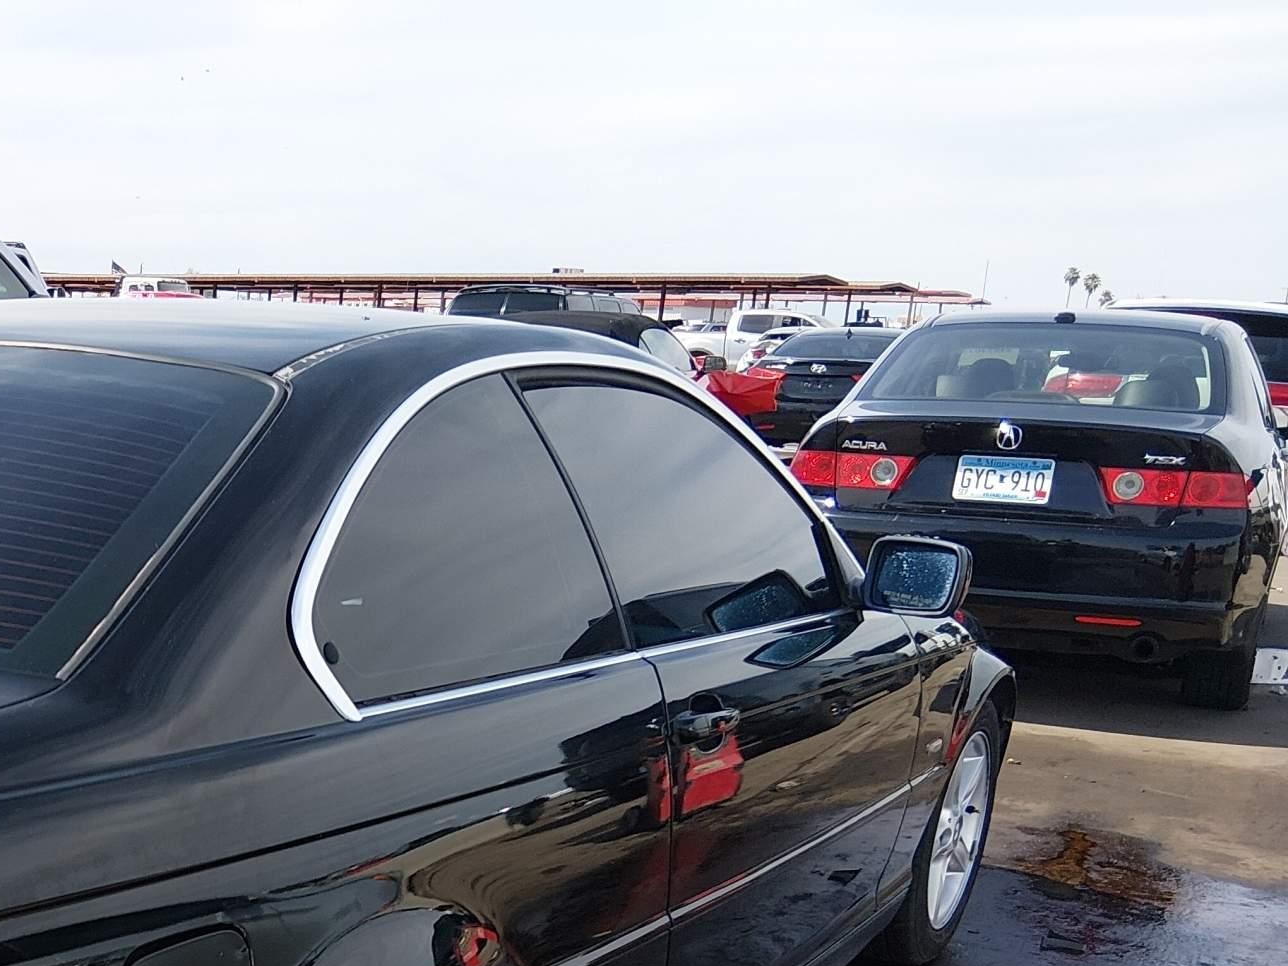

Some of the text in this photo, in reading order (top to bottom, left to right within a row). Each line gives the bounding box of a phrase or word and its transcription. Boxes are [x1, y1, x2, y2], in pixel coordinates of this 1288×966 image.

[841, 439, 888, 451] ACURA
[983, 458, 1029, 470] Minnesota
[960, 468, 1046, 492] GYC 910
